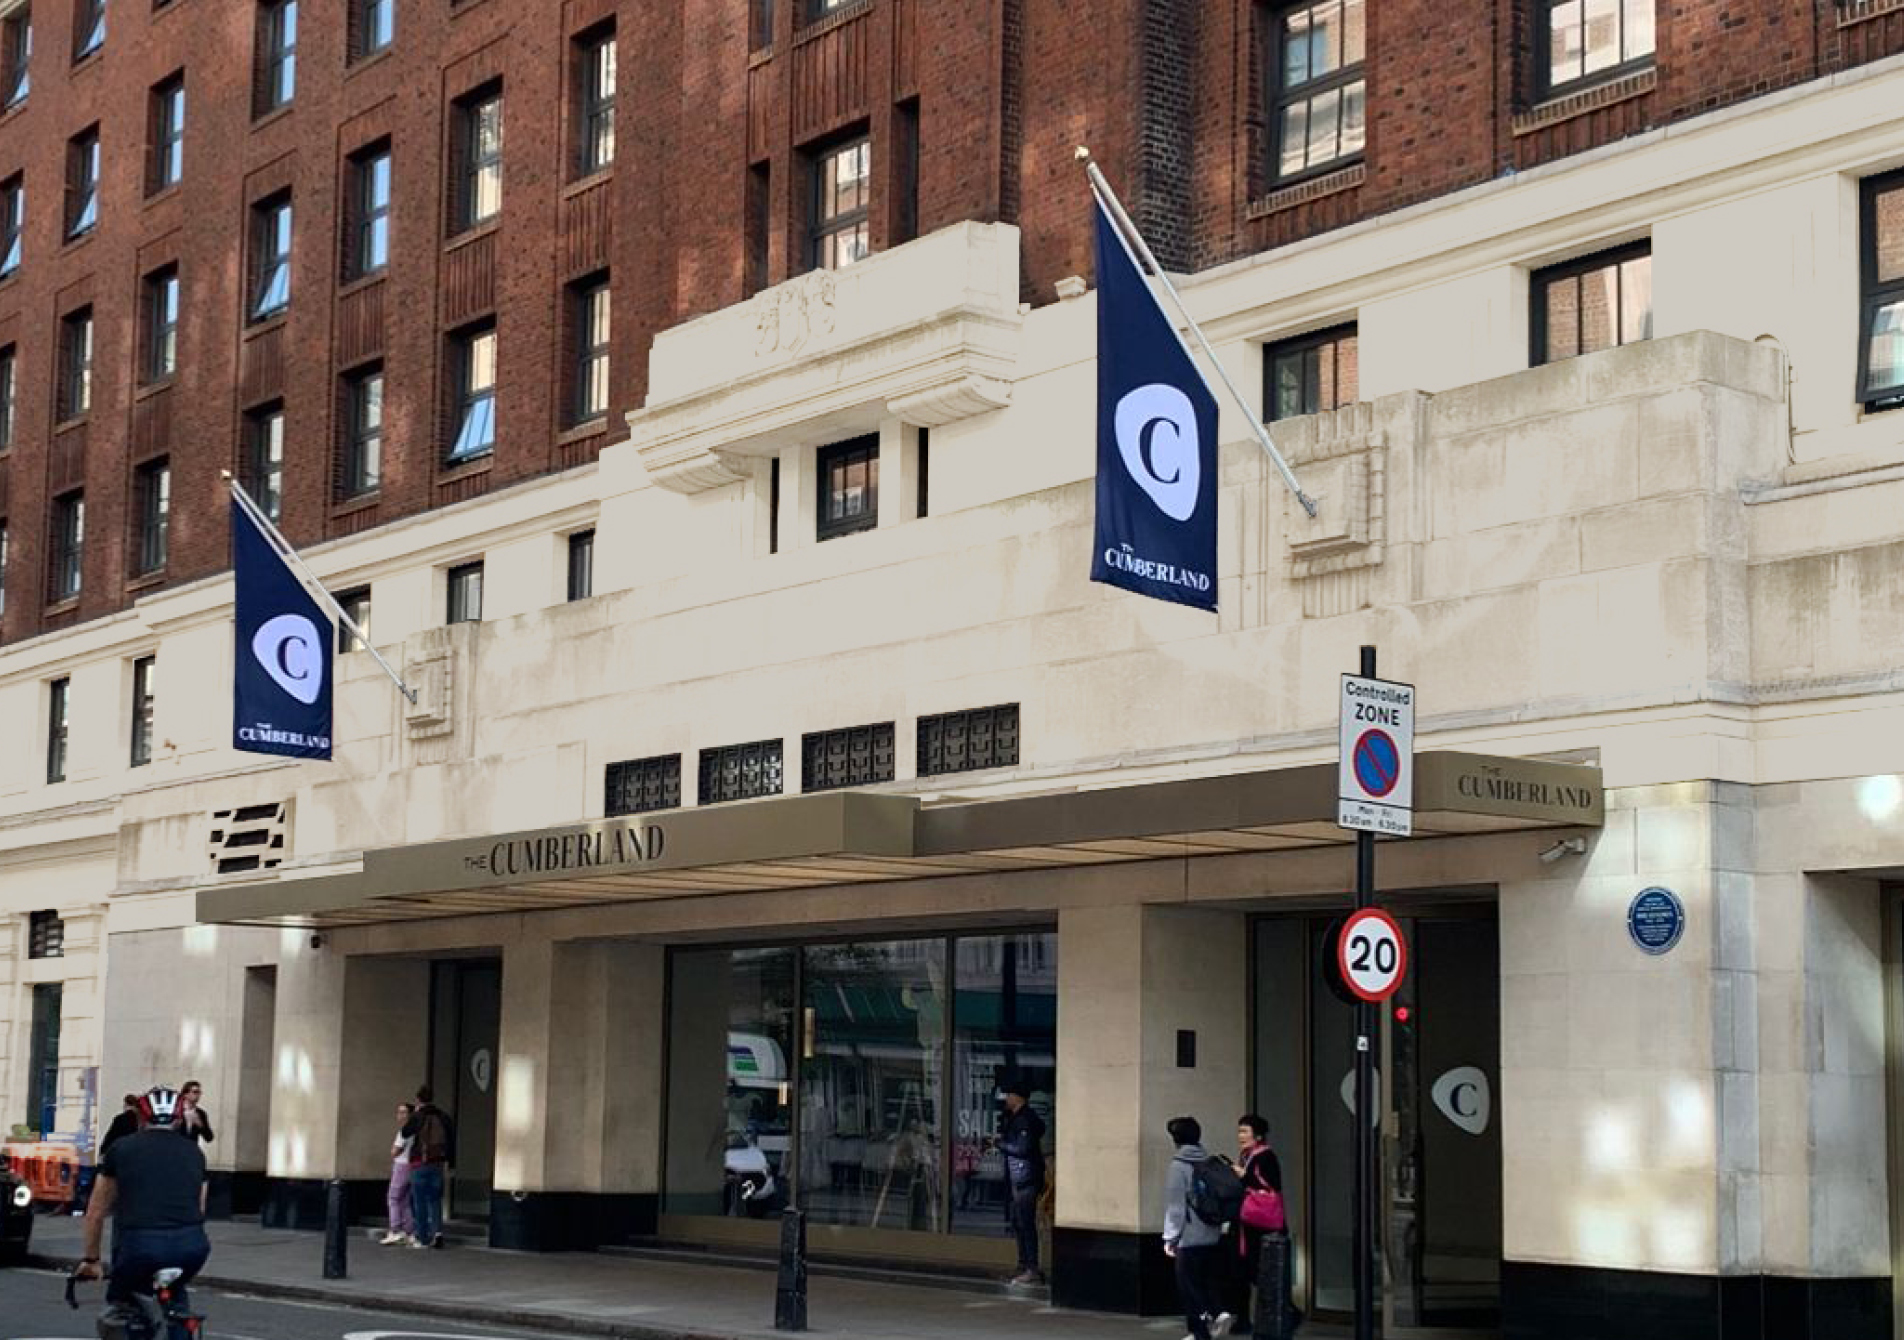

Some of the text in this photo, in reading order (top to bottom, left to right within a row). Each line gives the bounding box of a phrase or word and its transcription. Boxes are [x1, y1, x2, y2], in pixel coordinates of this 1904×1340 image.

[1140, 417, 1180, 484] C
[1104, 547, 1210, 592] CUMBERLAND
[277, 636, 308, 680] C
[1345, 680, 1410, 706] Controlled
[1355, 702, 1401, 727] ZONE
[239, 728, 330, 748] CUMBERLAND
[1458, 774, 1591, 808] CUMBERLAND
[464, 825, 665, 876] THE CUMBERLAND
[1351, 935, 1396, 974] 20
[1451, 1082, 1477, 1117] C
